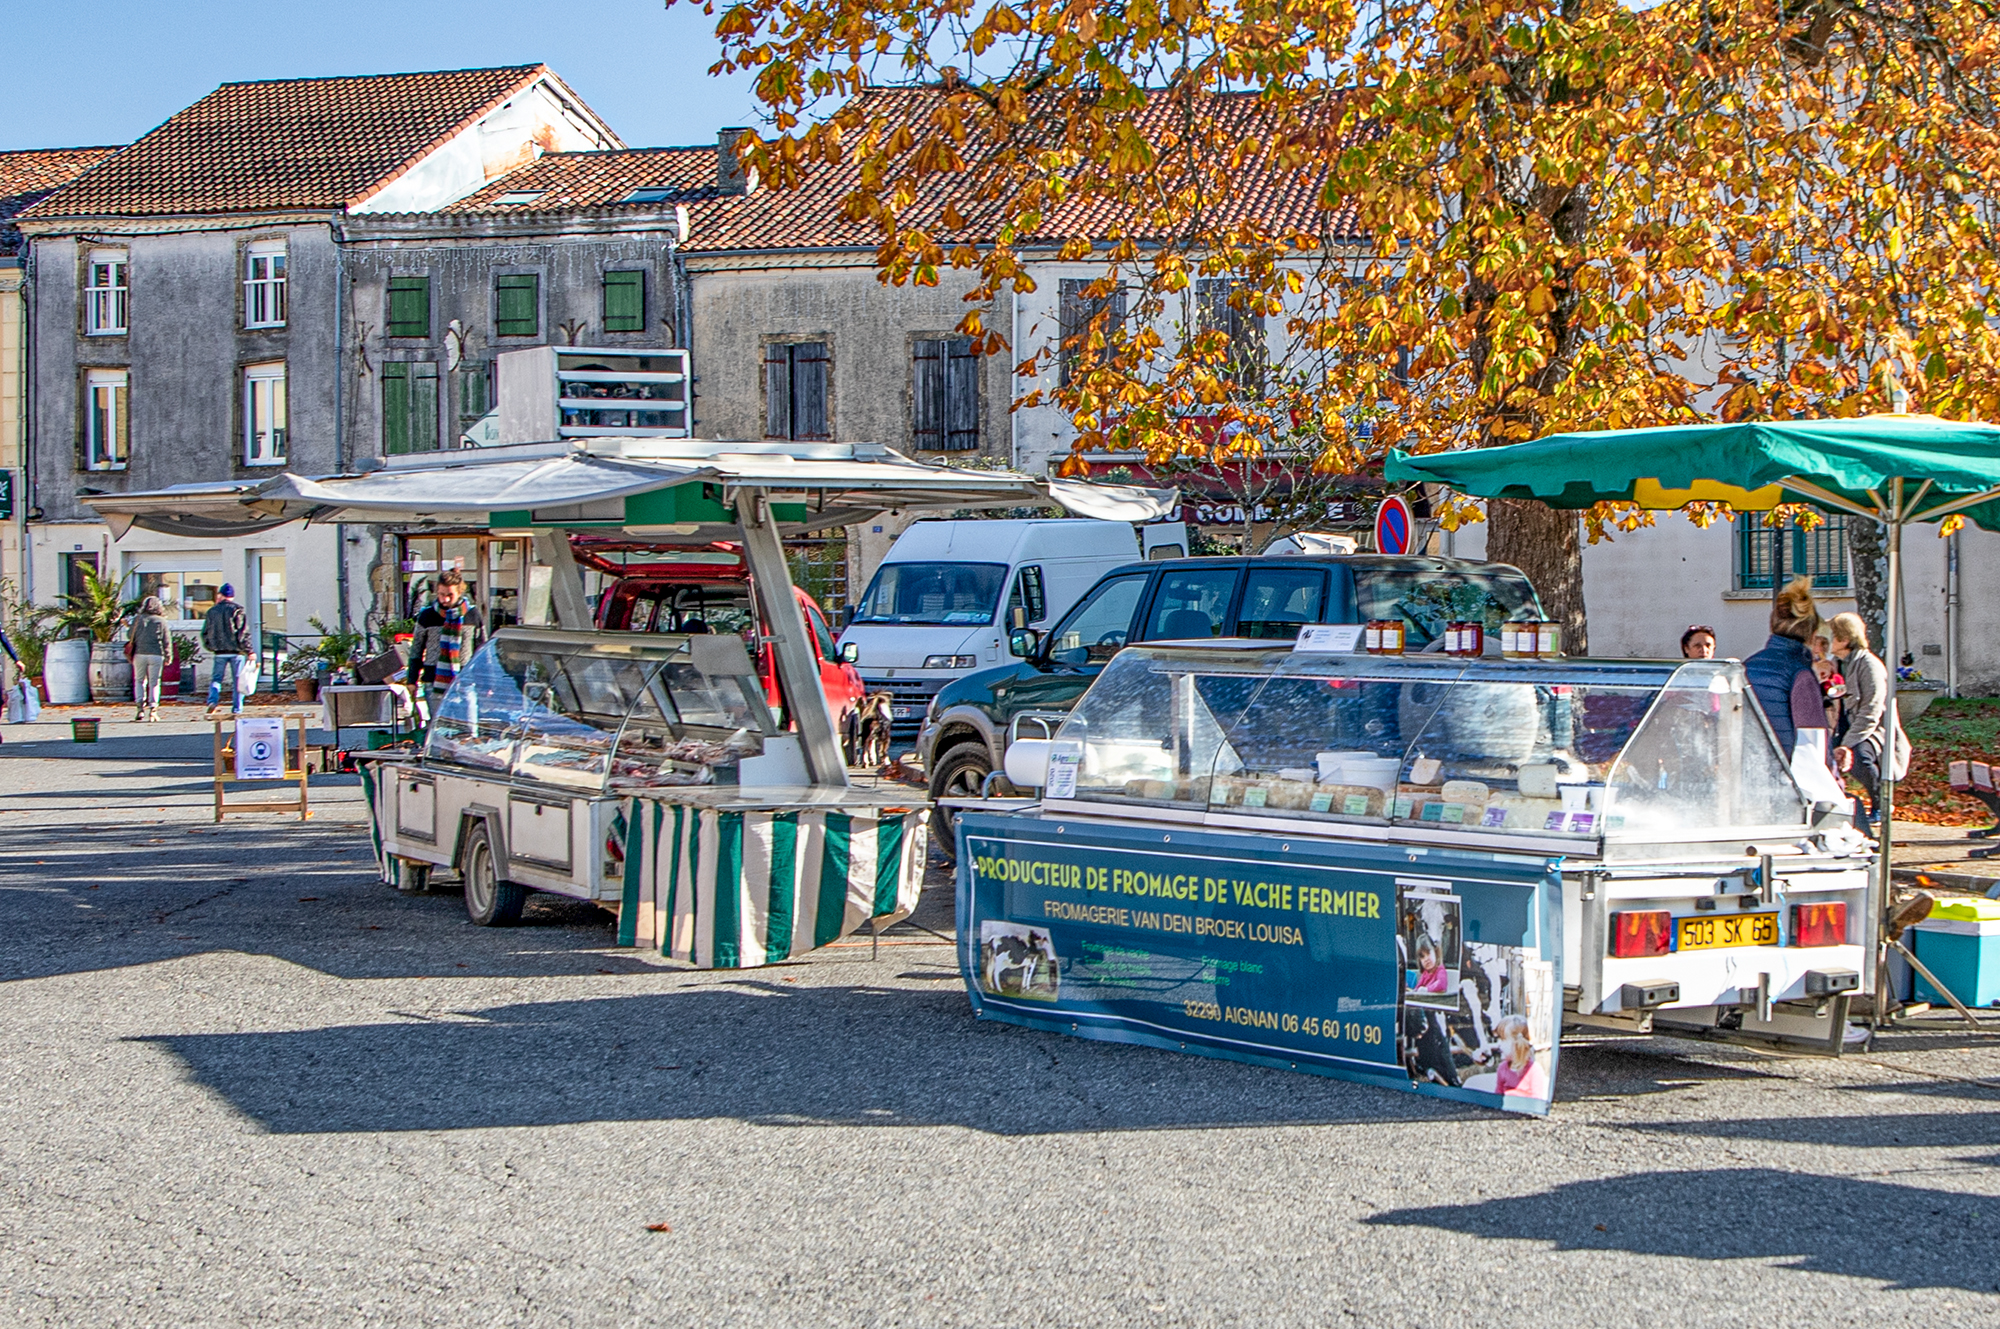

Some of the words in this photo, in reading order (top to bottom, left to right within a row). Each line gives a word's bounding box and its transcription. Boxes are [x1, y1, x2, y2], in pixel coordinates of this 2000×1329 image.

[978, 856, 1082, 890] PRODUCTEUR
[1086, 866, 1108, 892] DE
[1113, 869, 1198, 902] FROMAGE
[1204, 877, 1228, 903] DE
[1232, 880, 1292, 910] VACHE
[1298, 886, 1381, 919] FERMIER
[1044, 901, 1129, 927] FROMAGERIE
[1131, 910, 1160, 930] VAN
[1163, 914, 1192, 934] DEN
[1195, 917, 1246, 940] BROEK
[1249, 923, 1304, 946] LOUISA
[1684, 920, 1715, 946] 503
[1723, 919, 1743, 943] SK
[1752, 916, 1772, 941] 65
[1201, 955, 1239, 973] Fromage
[1239, 960, 1264, 975] blanc
[1202, 971, 1231, 987] Beurre
[1183, 999, 1222, 1022] 32290
[1225, 1006, 1279, 1031] AIGNAN
[1281, 1013, 1299, 1033] 06
[1302, 1017, 1320, 1036] 45
[1322, 1019, 1340, 1039] 60
[1344, 1022, 1361, 1042] 10
[1363, 1025, 1382, 1045] 90
